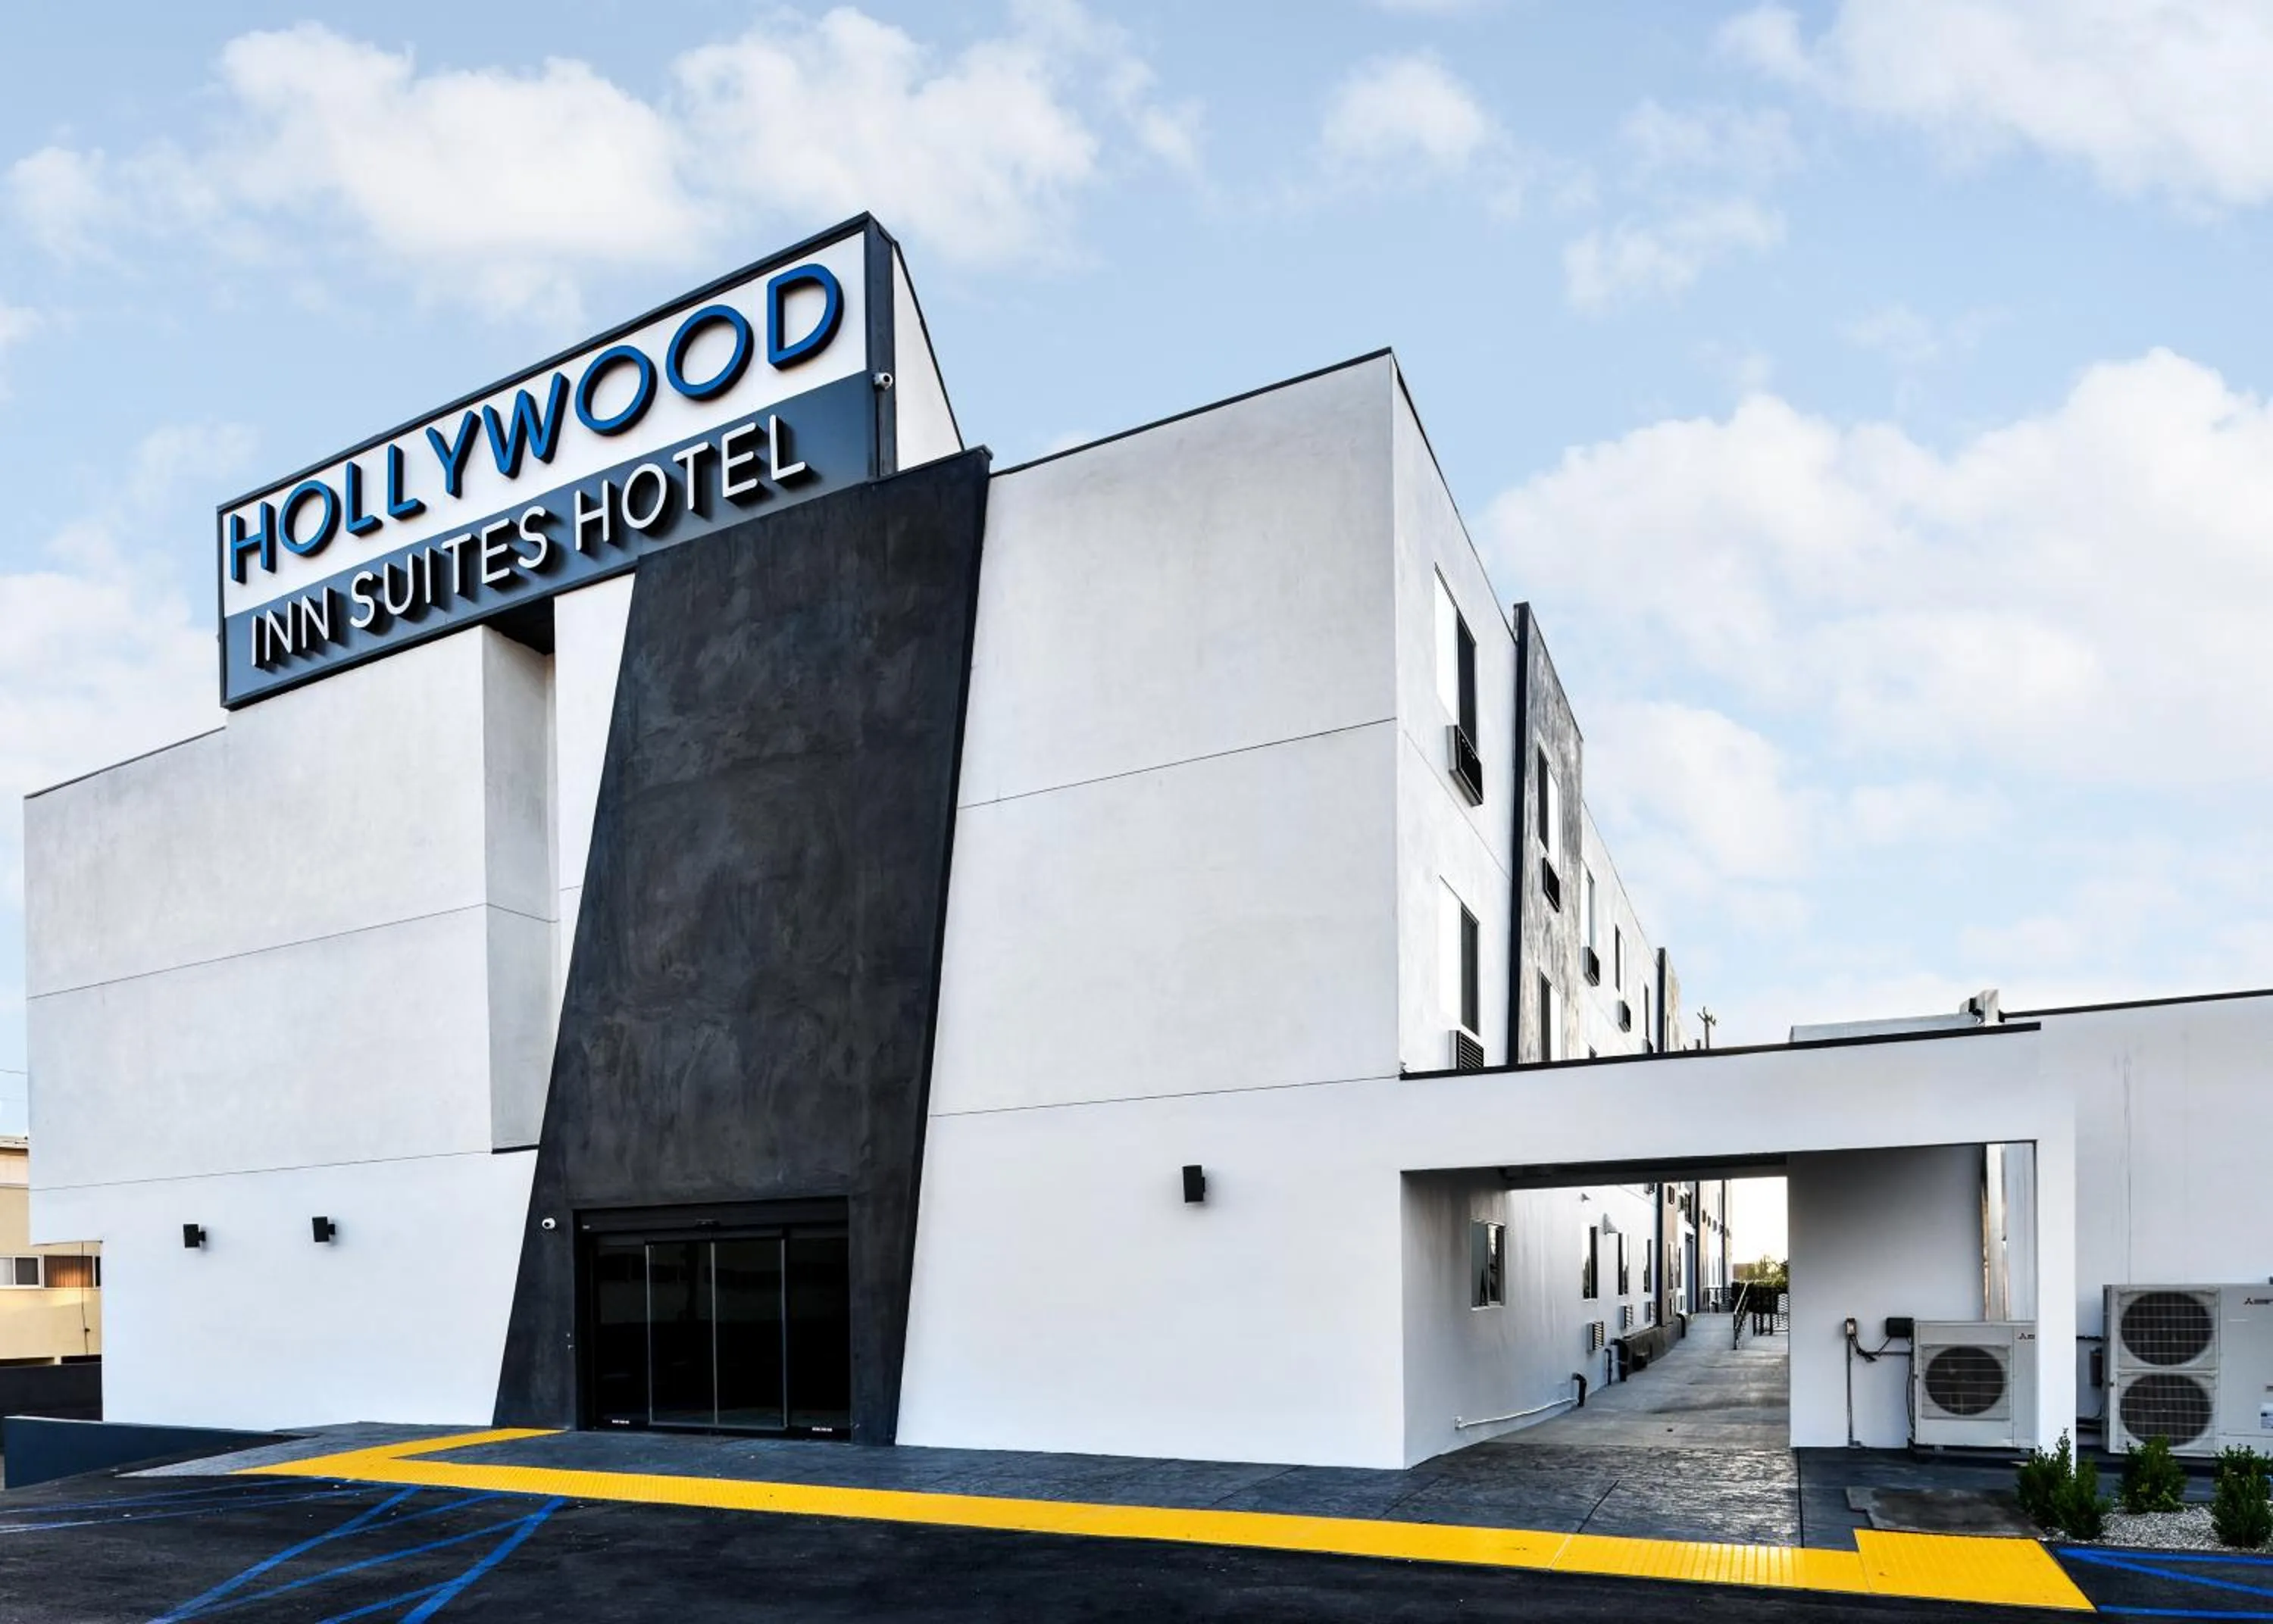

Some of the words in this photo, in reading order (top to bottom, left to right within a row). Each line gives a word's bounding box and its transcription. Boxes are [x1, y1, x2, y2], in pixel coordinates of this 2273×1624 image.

[230, 263, 843, 582] HOLLYWOOD
[251, 585, 333, 668] INN
[349, 505, 549, 630] SUITES
[574, 414, 808, 552] HOTEL
